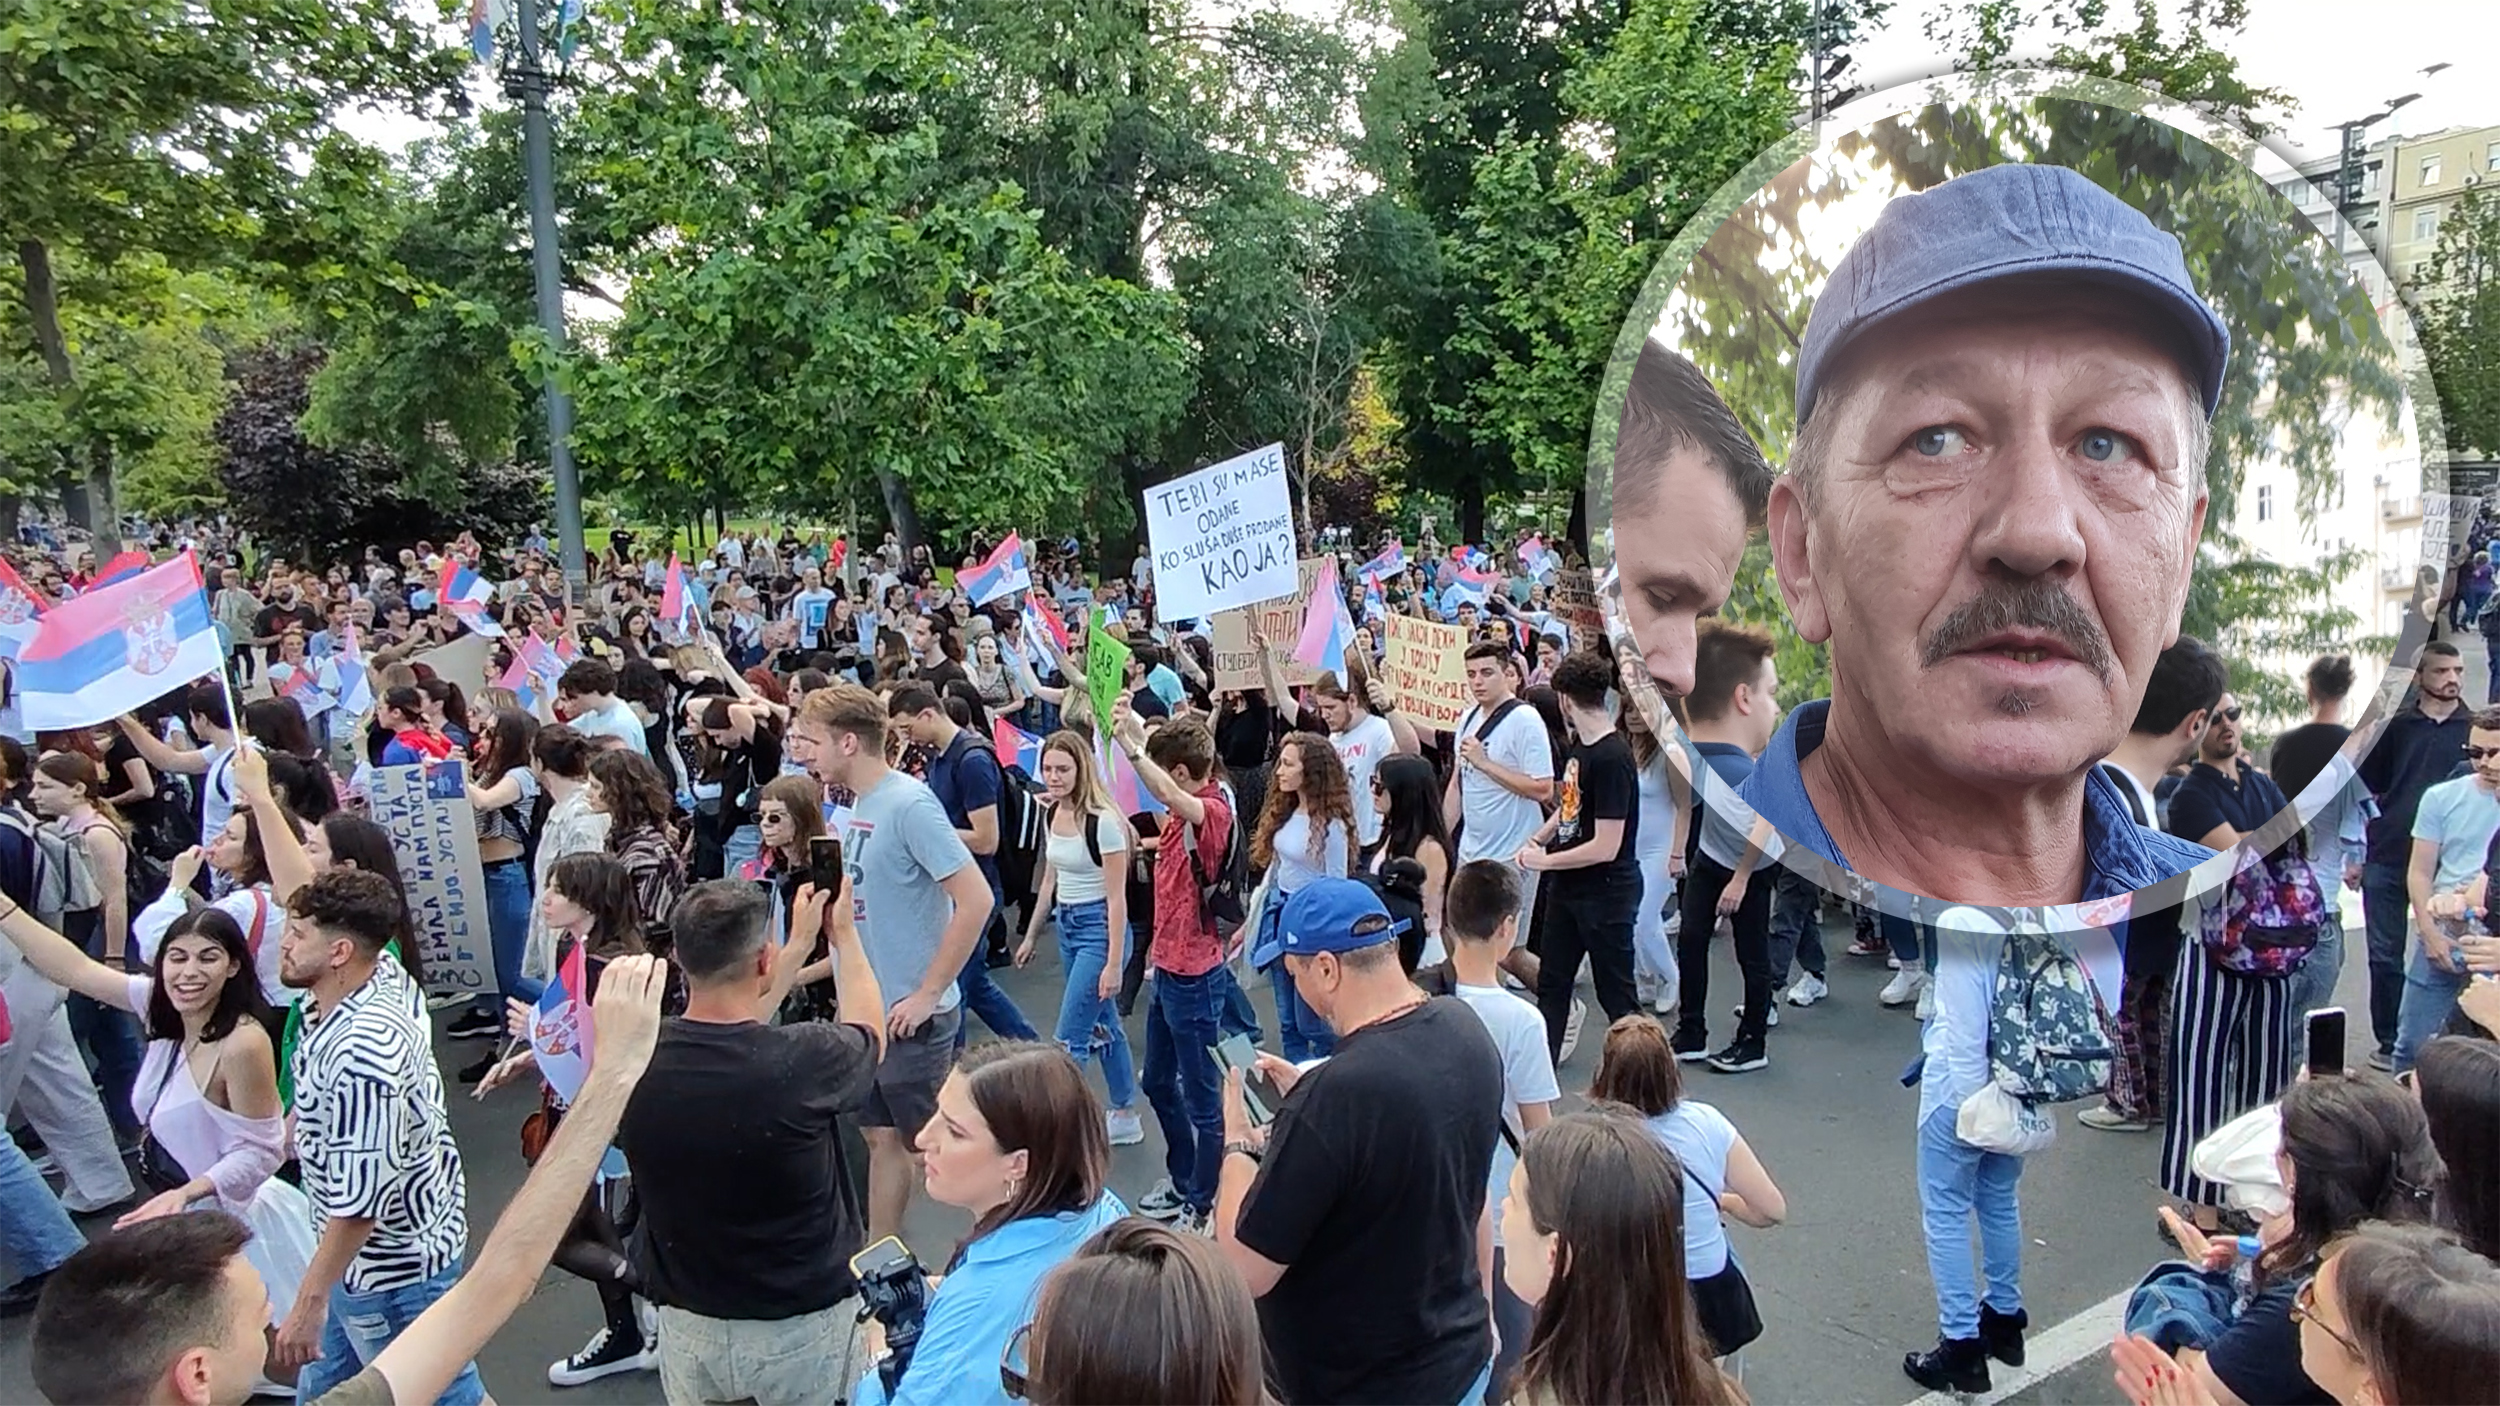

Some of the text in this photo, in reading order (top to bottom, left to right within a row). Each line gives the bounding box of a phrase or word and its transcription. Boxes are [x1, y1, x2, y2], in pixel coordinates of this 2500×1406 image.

[1157, 452, 1279, 517] TEBI SU MASE
[1197, 500, 1240, 534] ODANE
[1160, 551, 1180, 573] KO
[1246, 514, 1288, 539] PRODANE
[1201, 549, 1249, 595] KAO
[404, 768, 425, 828] ПУСТА
[413, 835, 434, 881] НАМ
